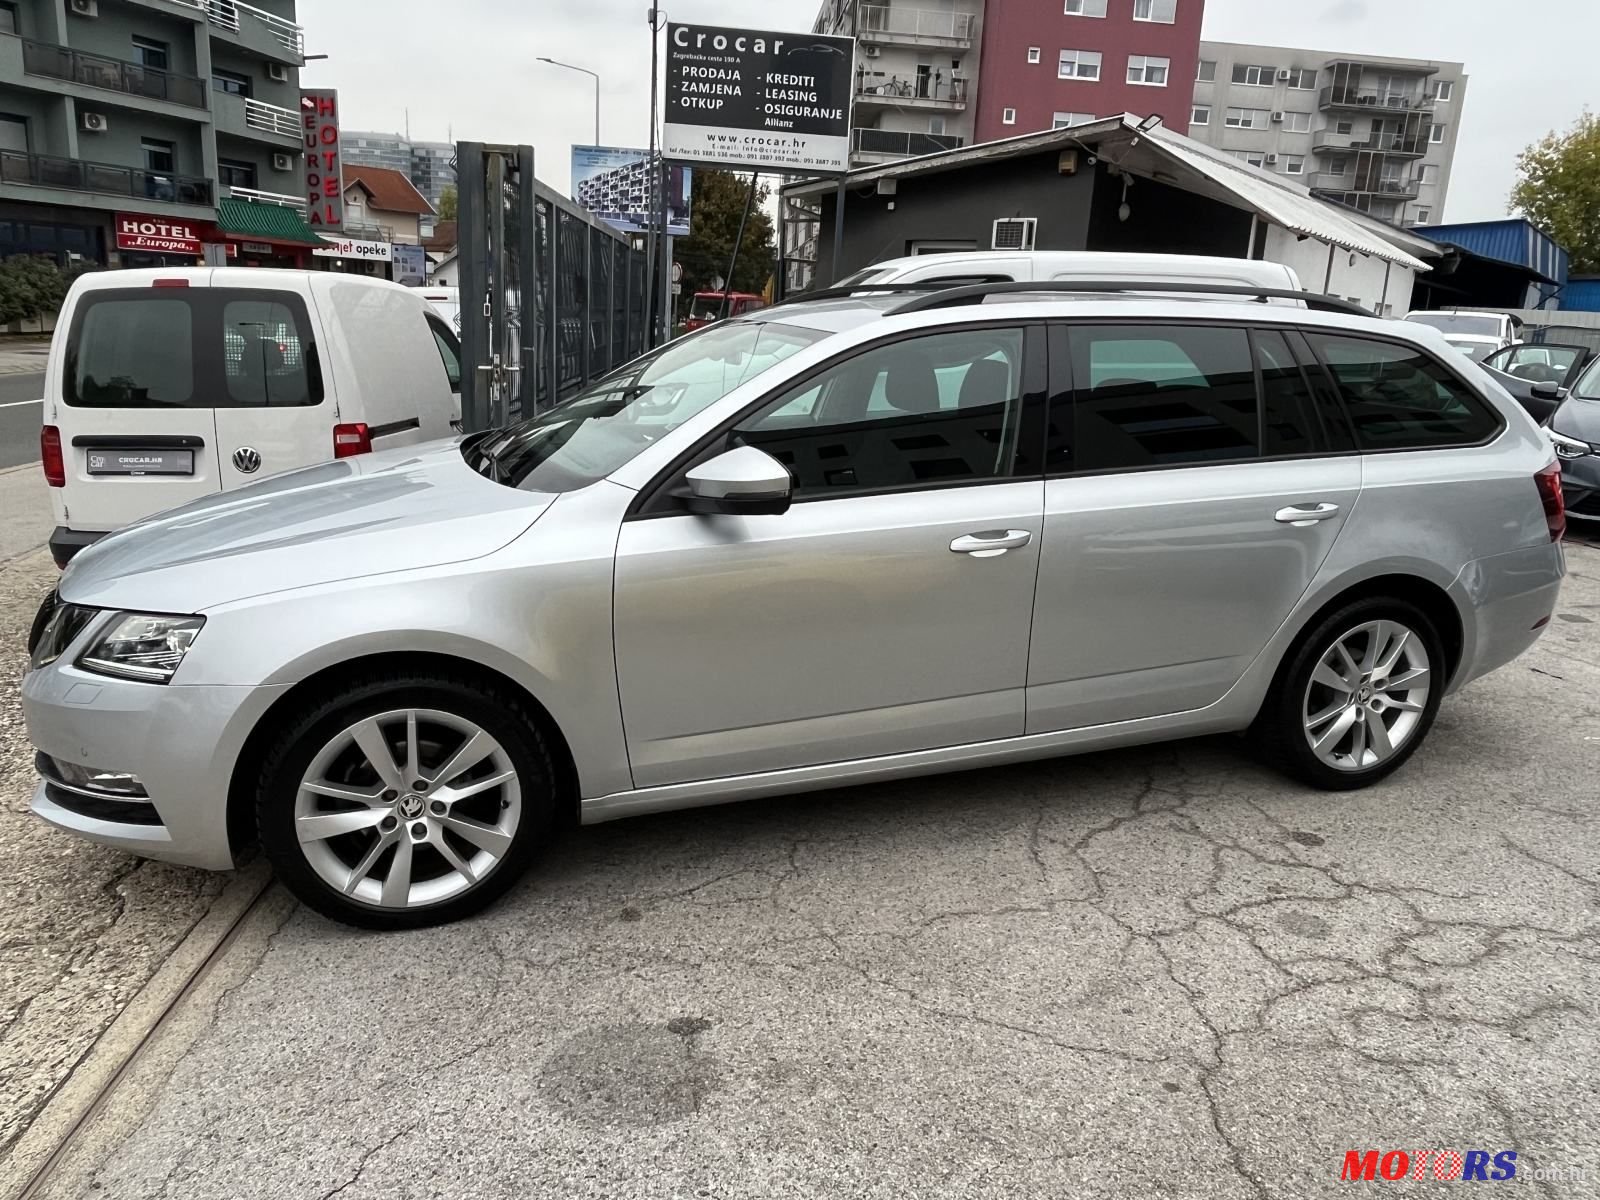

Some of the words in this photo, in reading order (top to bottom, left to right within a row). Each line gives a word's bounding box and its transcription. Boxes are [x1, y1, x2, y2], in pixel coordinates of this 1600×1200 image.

[674, 27, 784, 55] Crocar
[682, 65, 741, 80] PRODAJA
[766, 72, 815, 87] KREDITI
[681, 81, 742, 96] ZAMJENA
[765, 88, 817, 102] LEASING
[681, 96, 724, 110] OTKUP
[764, 103, 843, 119] OSIGURANJE
[764, 117, 794, 128] Allianz
[707, 134, 806, 148] www.crocar.hr
[319, 96, 340, 224] HOTEL
[305, 115, 321, 225] EUROPA
[123, 220, 196, 239] HOTEL
[356, 243, 387, 257] opeke
